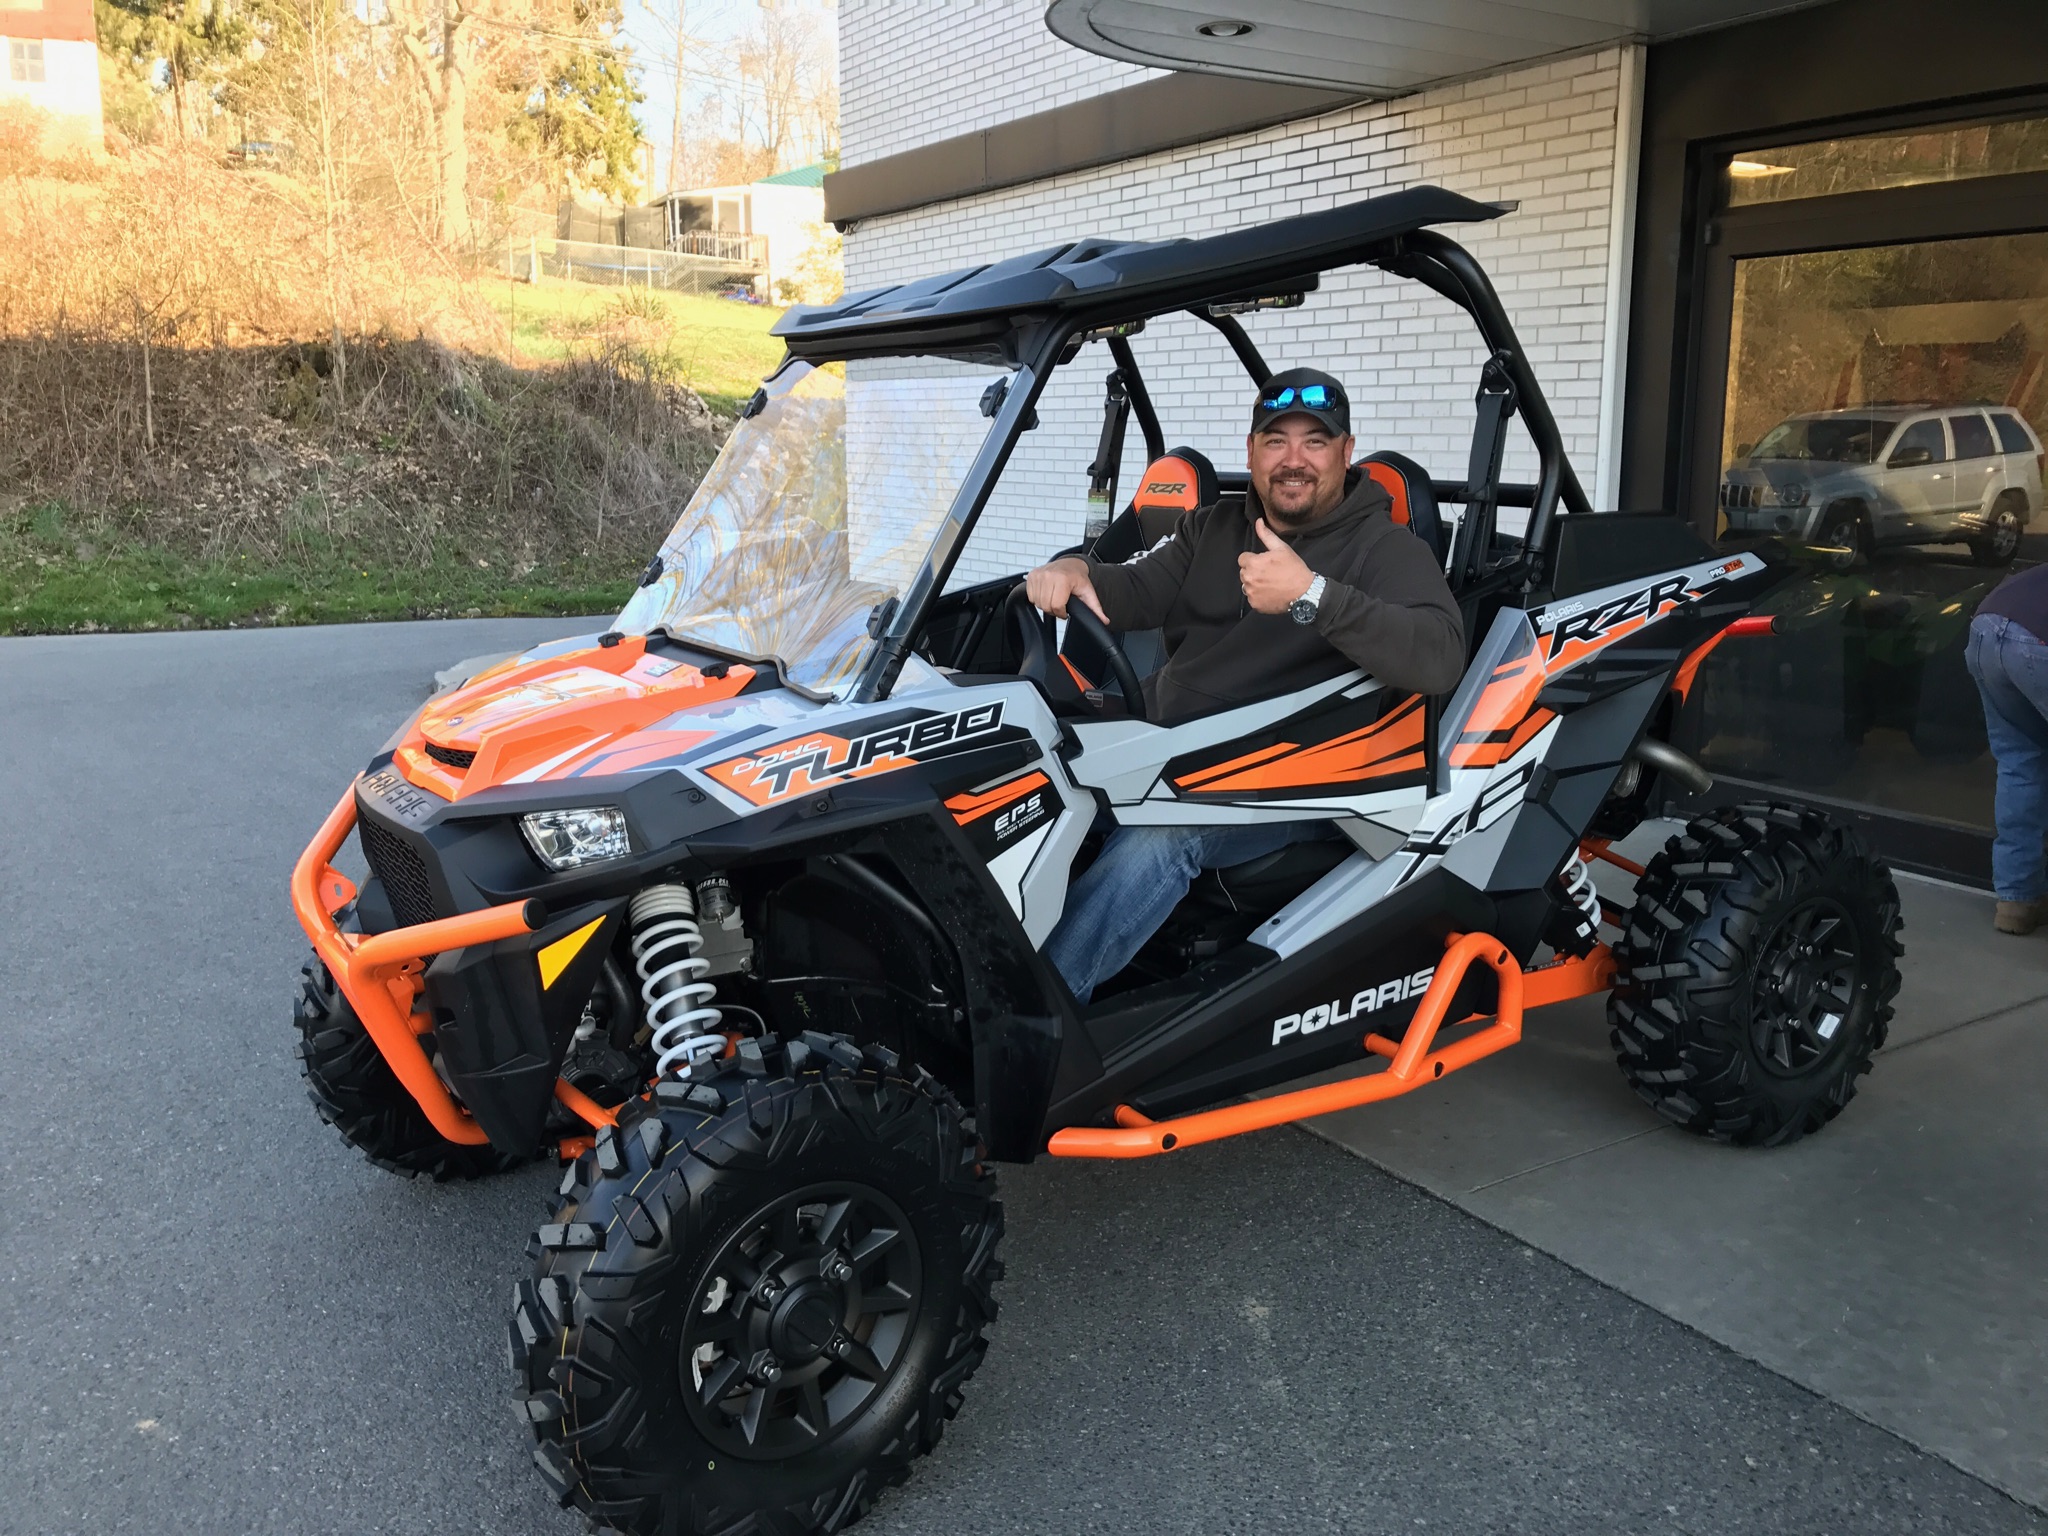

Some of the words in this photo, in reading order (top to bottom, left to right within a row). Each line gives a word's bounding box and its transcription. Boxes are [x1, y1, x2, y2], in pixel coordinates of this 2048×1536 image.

[1145, 483, 1187, 495] RZR
[1536, 601, 1584, 627] POLARIS
[1545, 573, 1696, 666] RZR
[731, 739, 823, 776] DOHC
[749, 697, 1008, 800] TURBO
[994, 793, 1042, 832] EPS
[996, 825, 1018, 842] POWER
[1018, 808, 1045, 829] STEERING
[1272, 966, 1436, 1046] POLARIS
